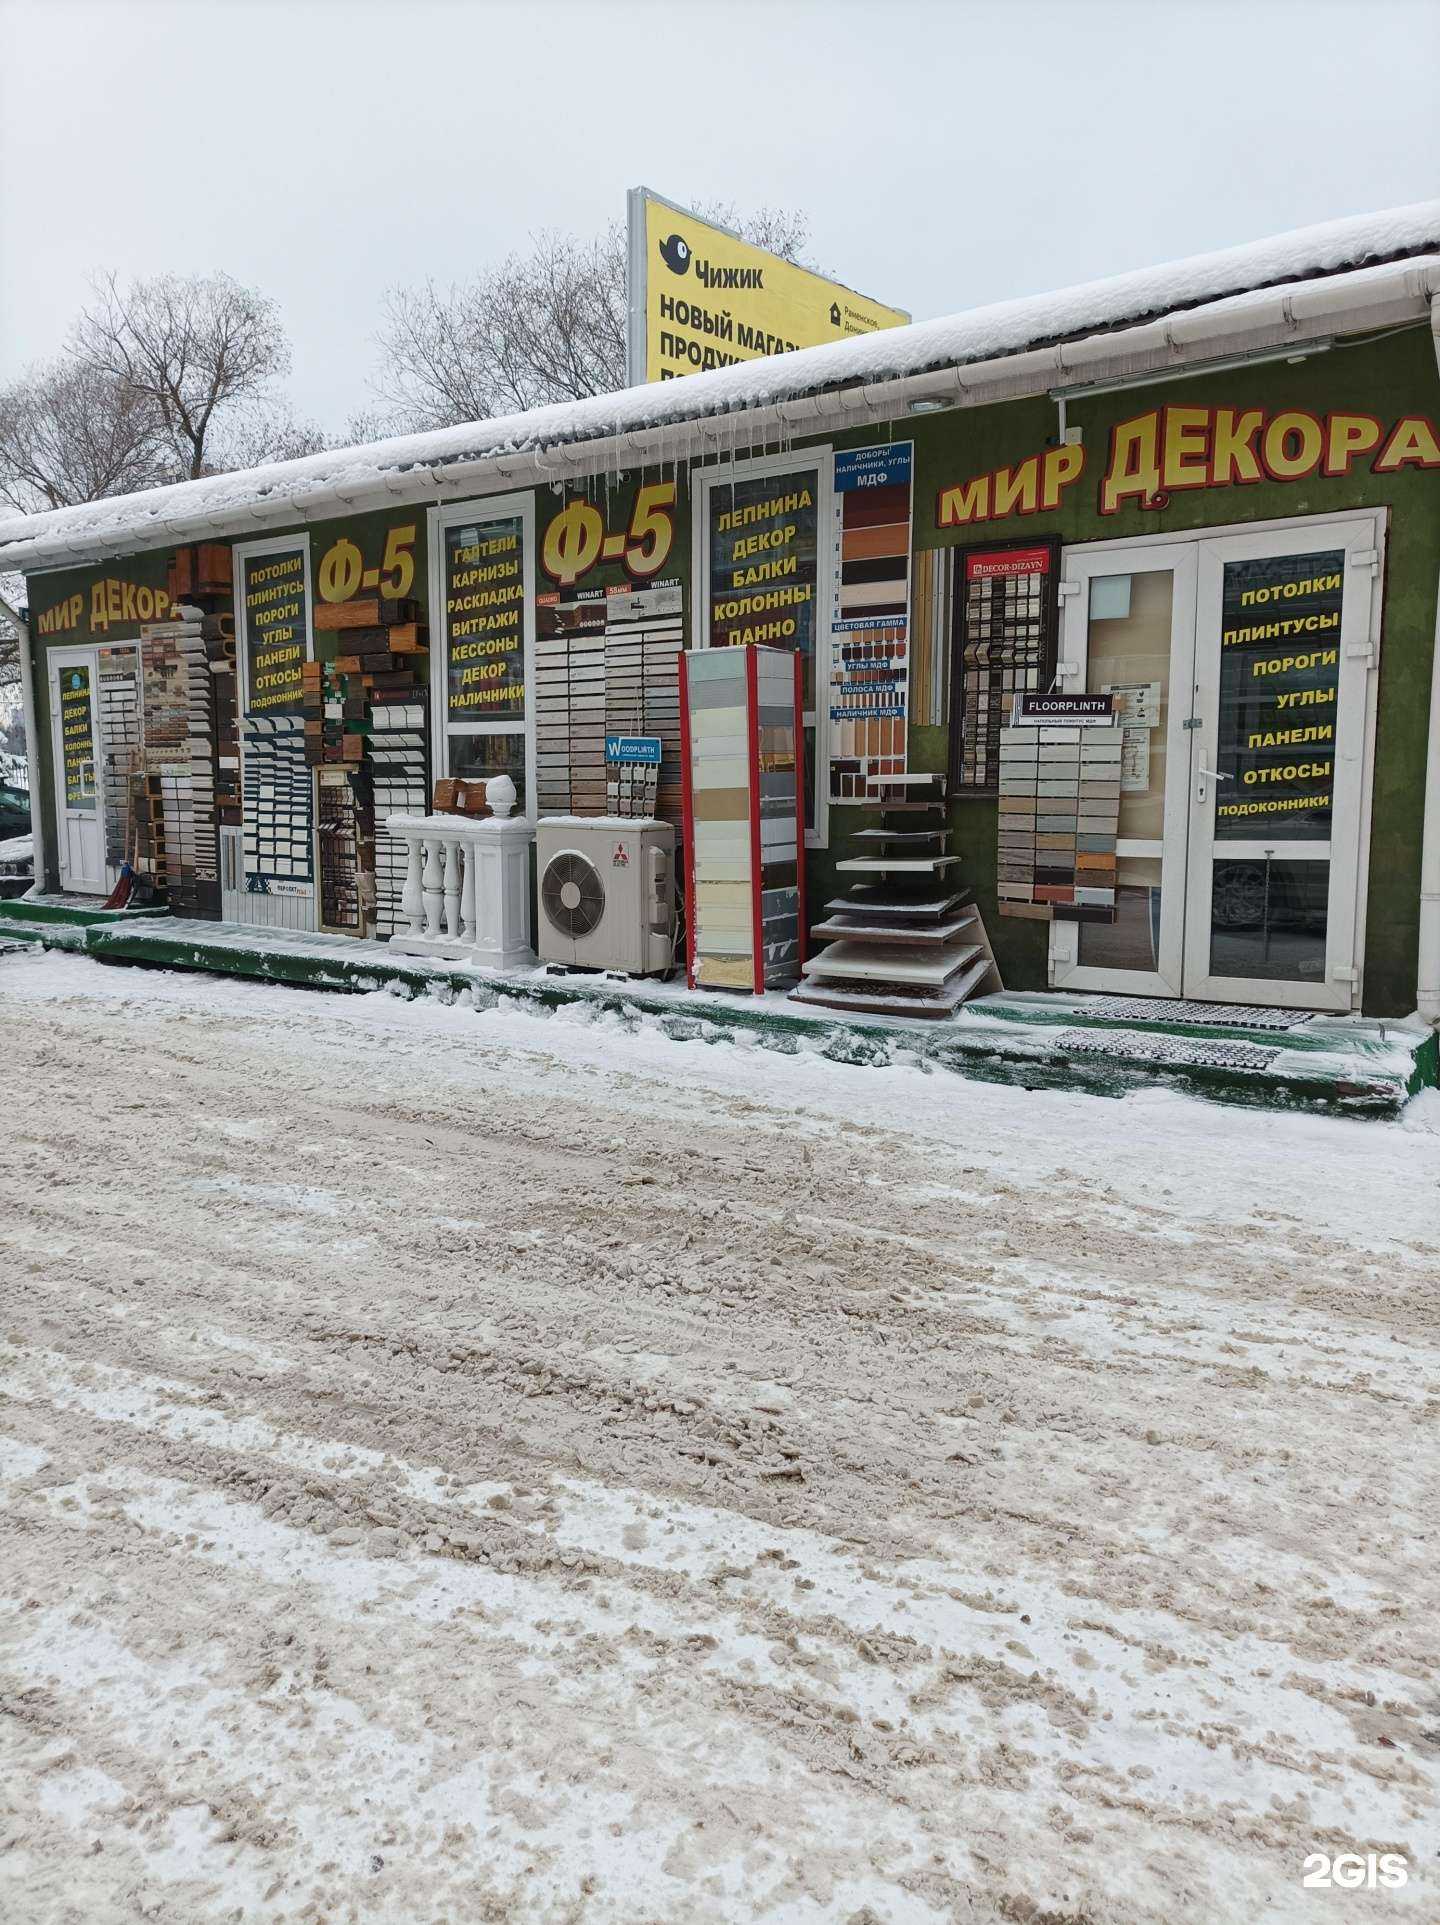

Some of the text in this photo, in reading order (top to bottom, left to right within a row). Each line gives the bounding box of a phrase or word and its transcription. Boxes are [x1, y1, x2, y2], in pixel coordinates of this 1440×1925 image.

[695, 260, 764, 289] Чижик
[660, 293, 800, 356] НОВЫЙ МАГАЗ
[855, 449, 890, 461] ДОБОРЫ
[888, 456, 911, 466] УГЛЫ
[938, 405, 1440, 528] МИР ДЕКОРА
[857, 472, 888, 487] МДФ
[718, 489, 812, 532] ЛЕПНИНА
[541, 481, 677, 585] Ф-5
[732, 525, 796, 561] ДЕКОР
[250, 557, 302, 585] ПОТОЛКИ
[317, 525, 417, 604] Ф-5
[452, 560, 518, 589] КАРНИЗЫ
[732, 556, 797, 588] БАЛКИ
[576, 589, 604, 600] WINART
[650, 577, 680, 589] WINART
[1241, 574, 1341, 606] ПОТОЛКИ
[447, 583, 525, 613] РАСКЛАДКА
[714, 584, 811, 621] КОЛОННЫ
[37, 592, 84, 635] МИР
[255, 603, 299, 626] ПОРОГИ
[452, 610, 518, 637] ВИТРАЖИ
[834, 619, 905, 631] ЦВЕТОВАЯ ГАММА
[262, 626, 293, 646] УГЛЫ
[728, 618, 796, 646] ПАННО
[1223, 612, 1340, 646] ПЛИНТУСЫ
[256, 646, 300, 669] ПАНЕЛИ
[452, 635, 518, 662] КЕССОНЫ
[461, 662, 507, 686] ДЕКОР
[847, 662, 869, 670] УГЛЫ
[1253, 650, 1337, 677] ПОРОГИ
[256, 667, 302, 689] ОТКОСЫ
[250, 689, 304, 709] ПОДОКОННИК
[450, 684, 525, 708] НАЛИЧНИКИ
[1029, 701, 1106, 711] FLOORPLINTH
[1276, 687, 1335, 709] УГЛЫ
[64, 705, 87, 720] ДЕКОР
[836, 708, 898, 718] НАЛИЧНИК МДФ
[64, 723, 88, 736] БАЛКИ
[1248, 724, 1332, 749] ПАНЕЛИ
[67, 771, 97, 786] БАГТЫ
[1243, 761, 1331, 785] ОТКОСЫ
[1218, 795, 1329, 816] ПОДОКОННИКИ
